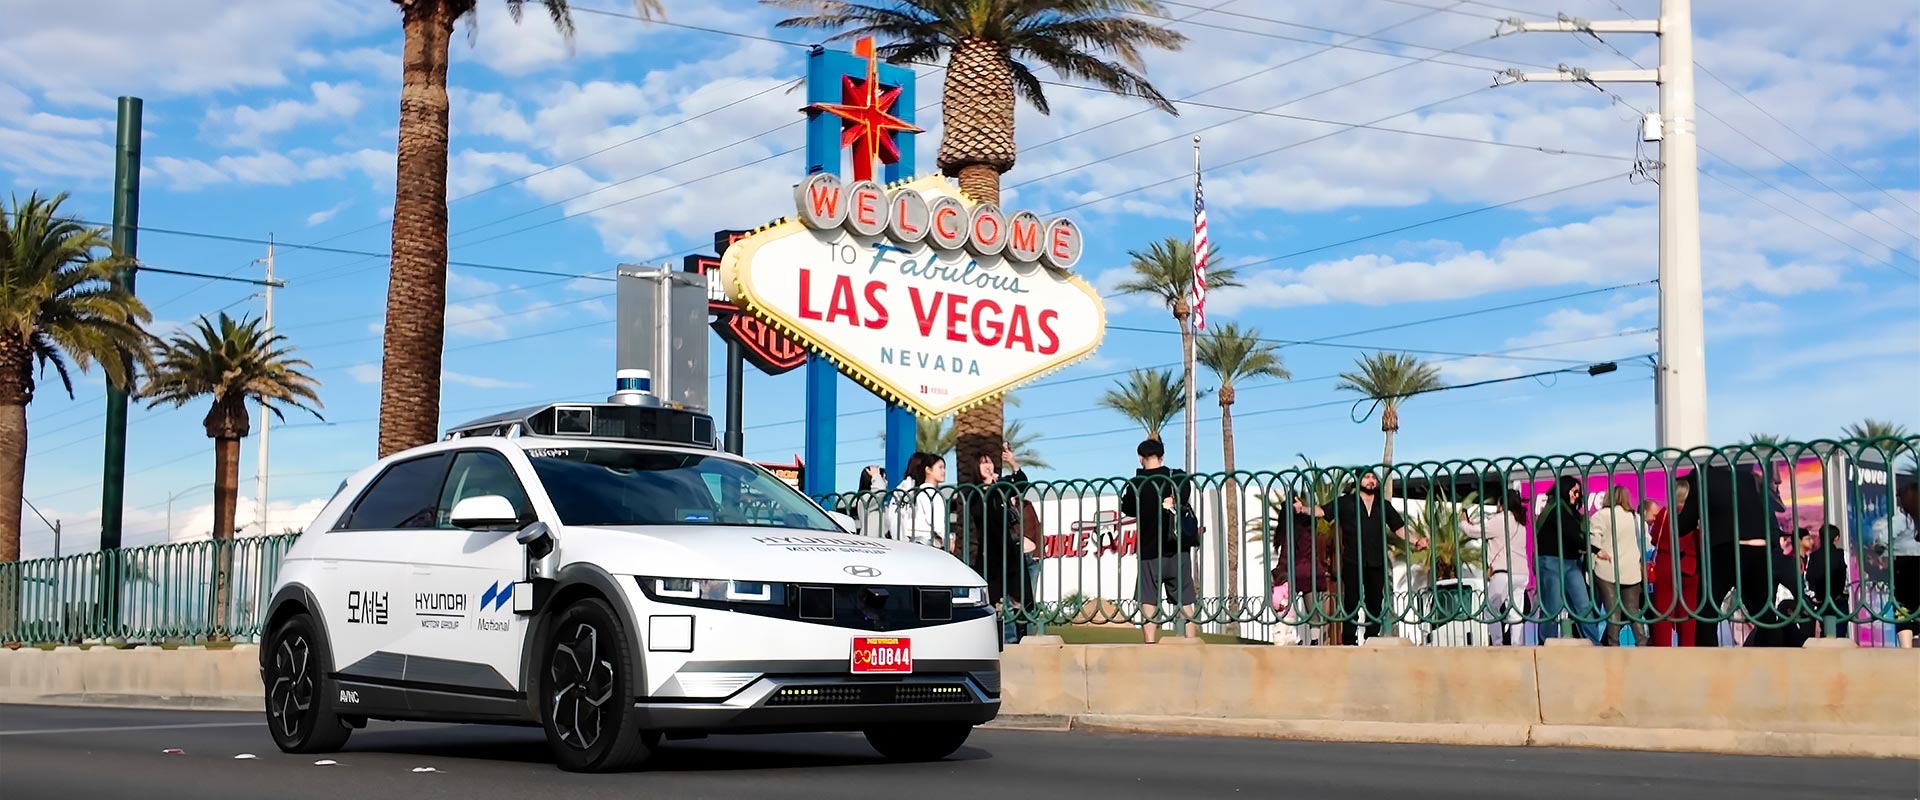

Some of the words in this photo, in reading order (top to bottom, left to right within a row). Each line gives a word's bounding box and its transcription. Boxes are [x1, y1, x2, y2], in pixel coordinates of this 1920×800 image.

[810, 184, 1070, 259] WELCOME
[827, 241, 857, 264] TO
[868, 242, 1029, 293] Fabulous
[799, 268, 889, 330] LAS
[908, 286, 1060, 356] VEGAS
[881, 346, 981, 377] NEVADA
[752, 536, 887, 548] HYUNDAI
[838, 547, 887, 555] GROUP
[347, 590, 389, 625] 모셔널
[415, 592, 467, 611] HYUNDAI
[477, 618, 511, 632] Motional
